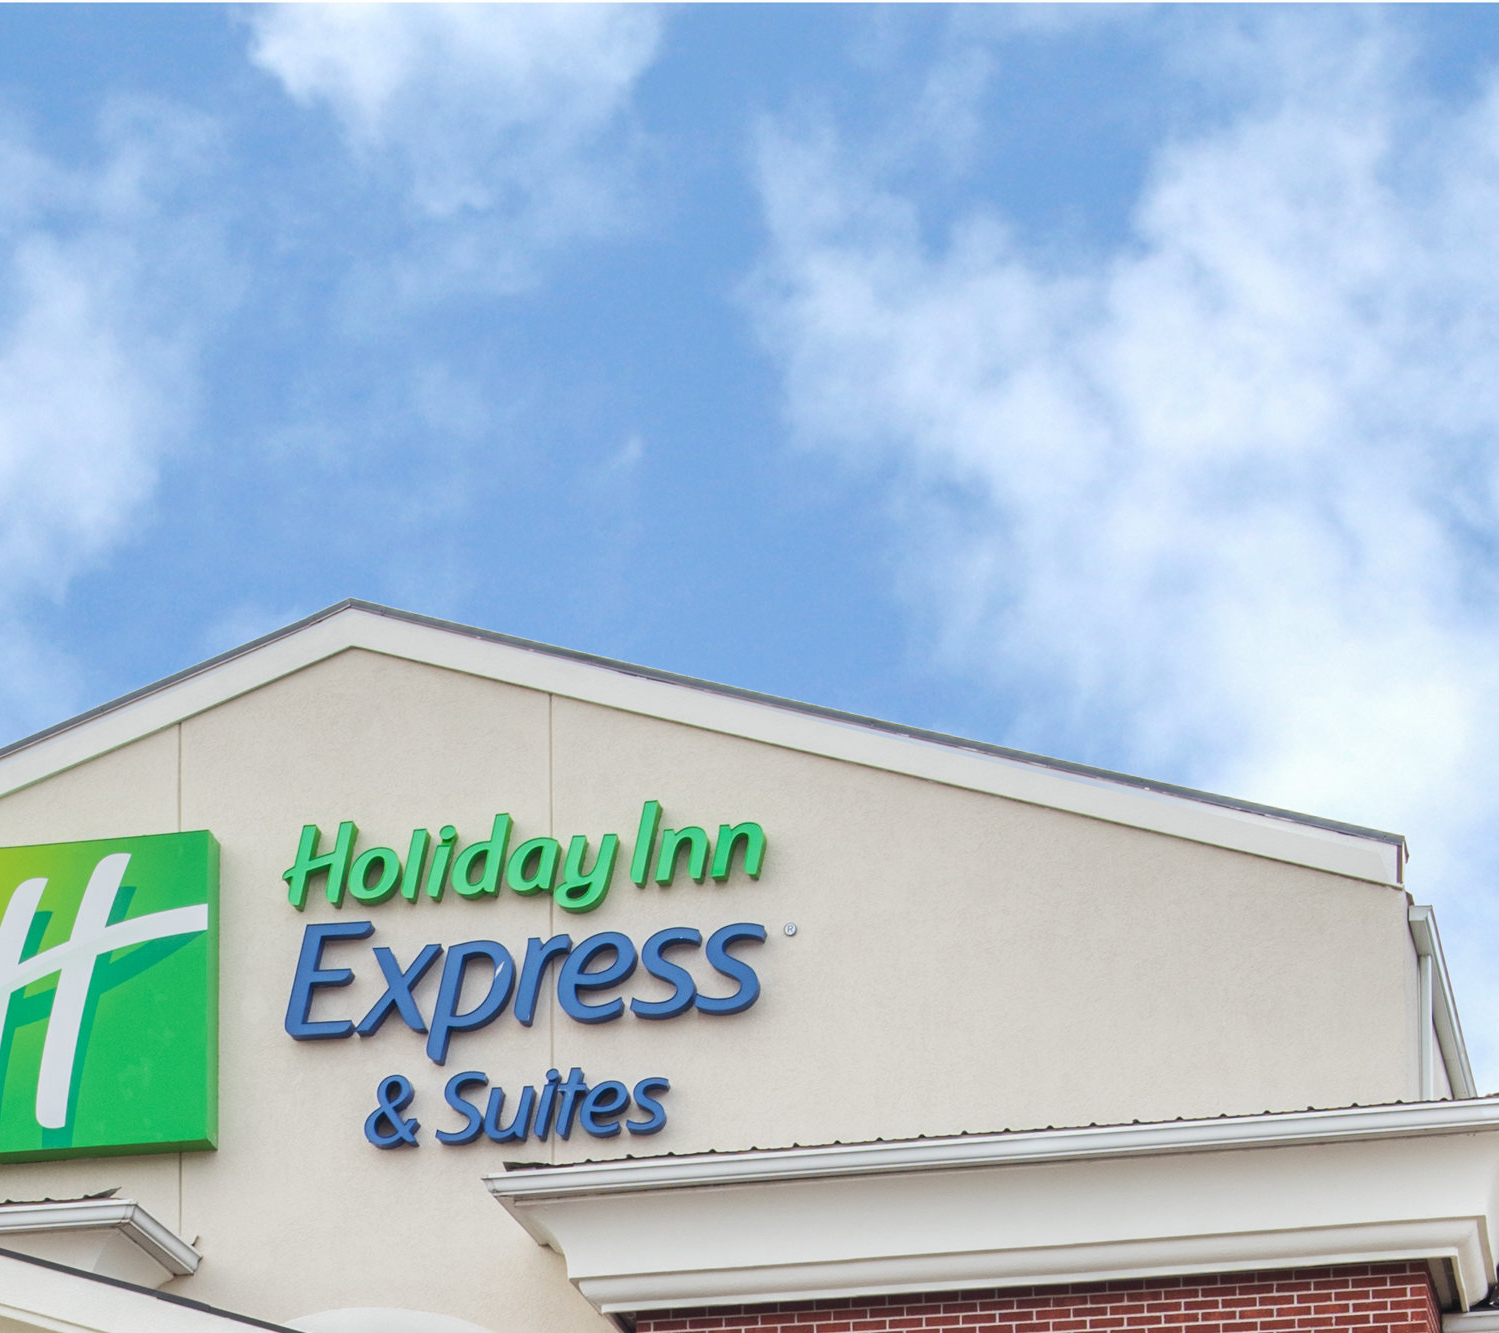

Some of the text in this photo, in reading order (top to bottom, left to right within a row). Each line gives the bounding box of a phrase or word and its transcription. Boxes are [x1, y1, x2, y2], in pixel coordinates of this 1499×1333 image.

[283, 800, 767, 914] Holiday Inn
[284, 921, 768, 1066] Express
[364, 1067, 671, 1150] & Suites
